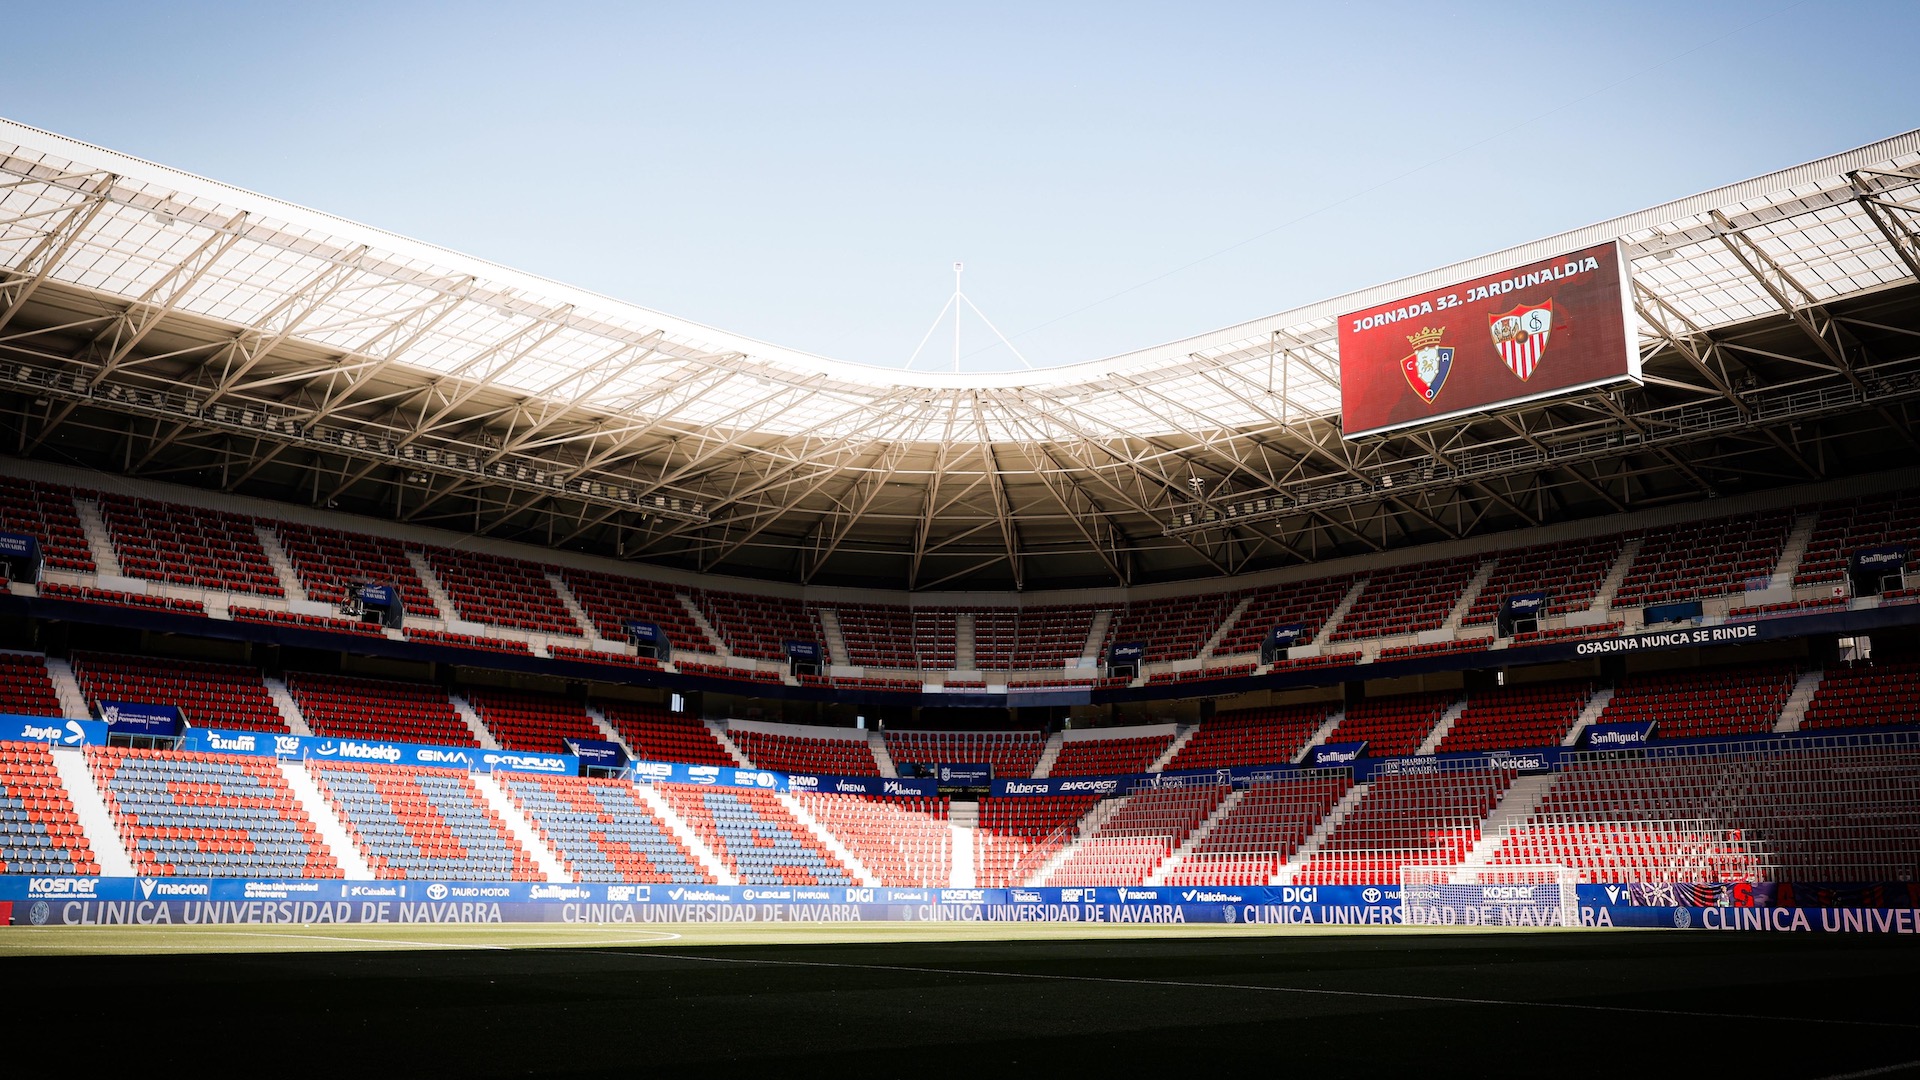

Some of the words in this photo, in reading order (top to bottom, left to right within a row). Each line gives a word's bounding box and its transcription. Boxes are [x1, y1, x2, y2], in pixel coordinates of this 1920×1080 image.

[1353, 299, 1433, 334] JORNADA
[1436, 293, 1463, 312] 32.
[1466, 256, 1599, 309] JARDUNALDIA
[1576, 638, 1639, 655] OSASUNA
[1641, 633, 1690, 649] NUNCA
[1692, 630, 1710, 642] SE
[1712, 624, 1758, 641] RINDE
[118, 717, 146, 725] Pamplona
[1589, 731, 1639, 745] SanMiguel
[211, 738, 255, 751] axium
[339, 741, 401, 763] Mobekip
[417, 749, 468, 764] GIMA
[1316, 751, 1355, 763] SanMiguel
[1491, 757, 1539, 769] Noticias
[796, 775, 819, 786] KWD
[836, 779, 866, 793] VIRENA
[1059, 780, 1117, 791] BARCARGO
[895, 784, 922, 796] elektra
[1005, 782, 1049, 794] Rubersa
[157, 883, 208, 895] macron
[272, 882, 319, 892] Universidad
[361, 887, 396, 896] CaixaBank
[452, 887, 479, 897] TAURO
[480, 887, 510, 898] MOTOR
[529, 885, 580, 901] SanMiguel
[253, 891, 288, 899] Navarra
[684, 889, 715, 901] Halcón
[755, 891, 791, 899] LEXUS
[797, 891, 830, 900] PAMPLONA
[846, 888, 874, 902] DIGI
[1128, 891, 1157, 900] macron
[1197, 892, 1227, 902] Halcón
[1283, 887, 1318, 902] DIGI
[62, 901, 172, 925] CLINICA
[183, 901, 352, 924] UNIVERSIDAD
[361, 902, 391, 923] DE
[398, 902, 503, 923] NAVARRA
[562, 903, 636, 923] CLINICA
[643, 903, 757, 922] UNIVERSIDAD
[762, 904, 783, 922] DE
[788, 904, 861, 922] NAVARRA
[919, 904, 983, 921] CLINICA
[988, 904, 1080, 922] UNIVERSIDAD
[1085, 905, 1105, 922] DE
[1109, 904, 1186, 923] NAVARRA
[1243, 905, 1315, 924] CLINICA
[1466, 906, 1496, 926] DE
[1702, 908, 1812, 933] CLINICA
